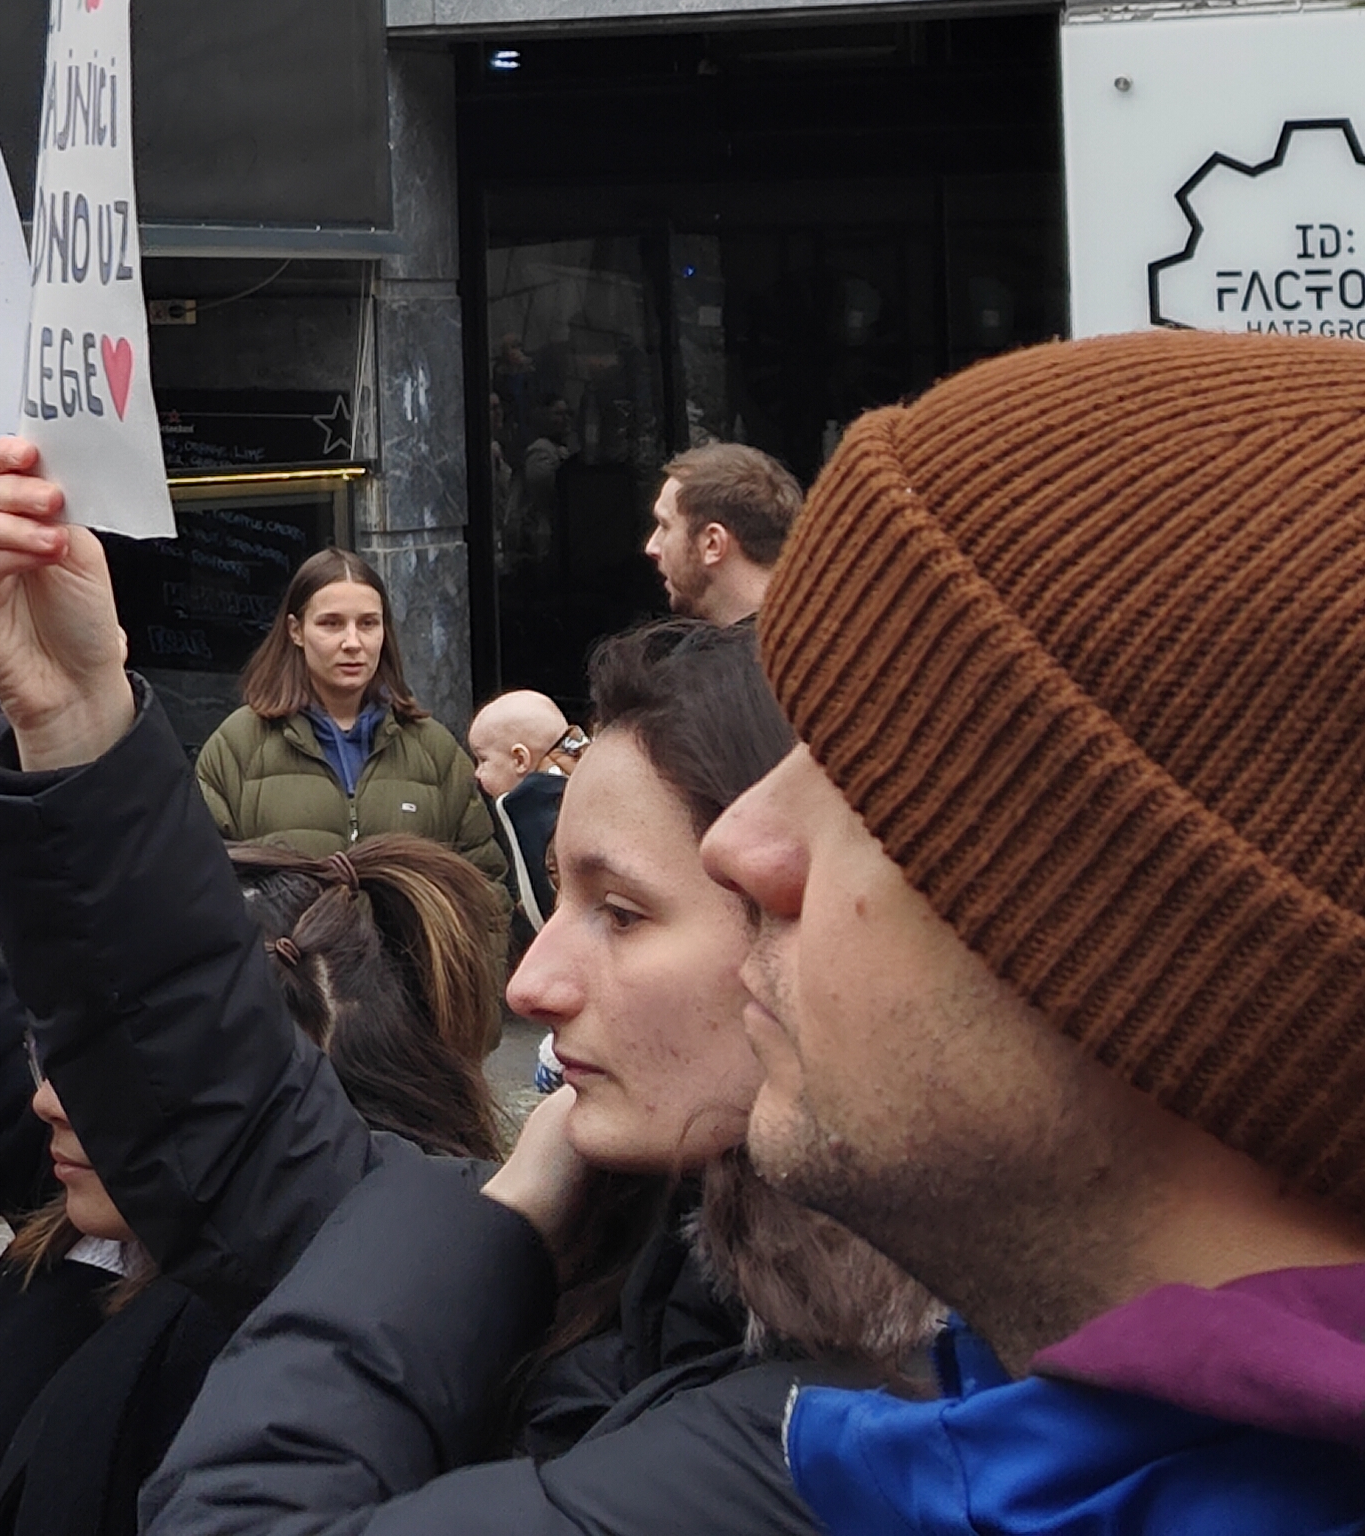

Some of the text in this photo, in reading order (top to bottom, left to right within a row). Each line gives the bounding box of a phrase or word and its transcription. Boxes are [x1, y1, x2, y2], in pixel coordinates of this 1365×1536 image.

[98, 200, 133, 286] UZ
[1295, 224, 1355, 259] ID:
[1216, 268, 1365, 312] FACTO
